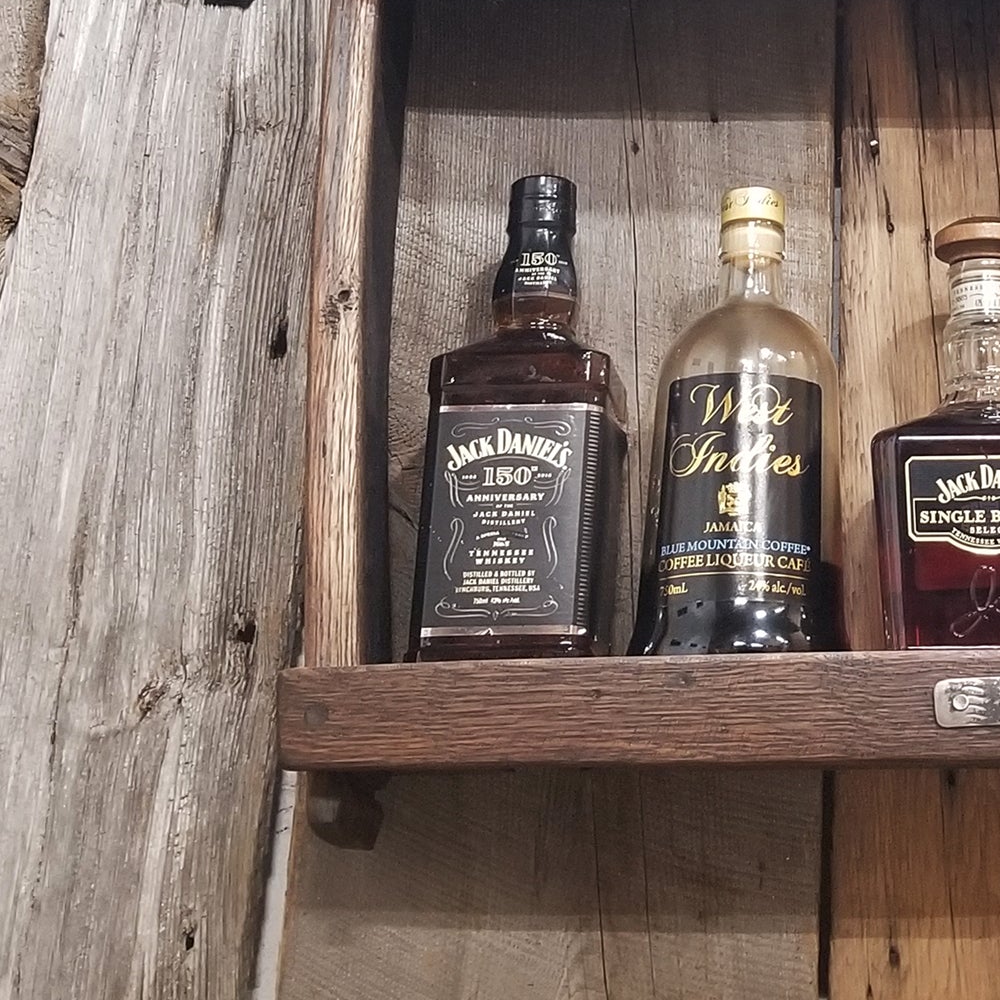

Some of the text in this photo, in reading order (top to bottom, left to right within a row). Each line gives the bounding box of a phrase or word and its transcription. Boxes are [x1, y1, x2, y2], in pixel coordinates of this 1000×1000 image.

[446, 428, 573, 471] JACK DANIEL'S
[670, 431, 809, 477] Indies
[936, 470, 980, 503] JACK
[466, 492, 545, 502] ANNIVERSARY
[919, 509, 986, 524] SINGLE
[704, 522, 763, 533] JAMAICA
[951, 527, 995, 545] TENNESSEE
[661, 542, 686, 556] BLUE
[687, 538, 758, 552] MOUNTAIN
[475, 557, 525, 565] WHISKEY
[658, 555, 704, 572] COFFEE
[706, 553, 775, 568] LIQUEUR
